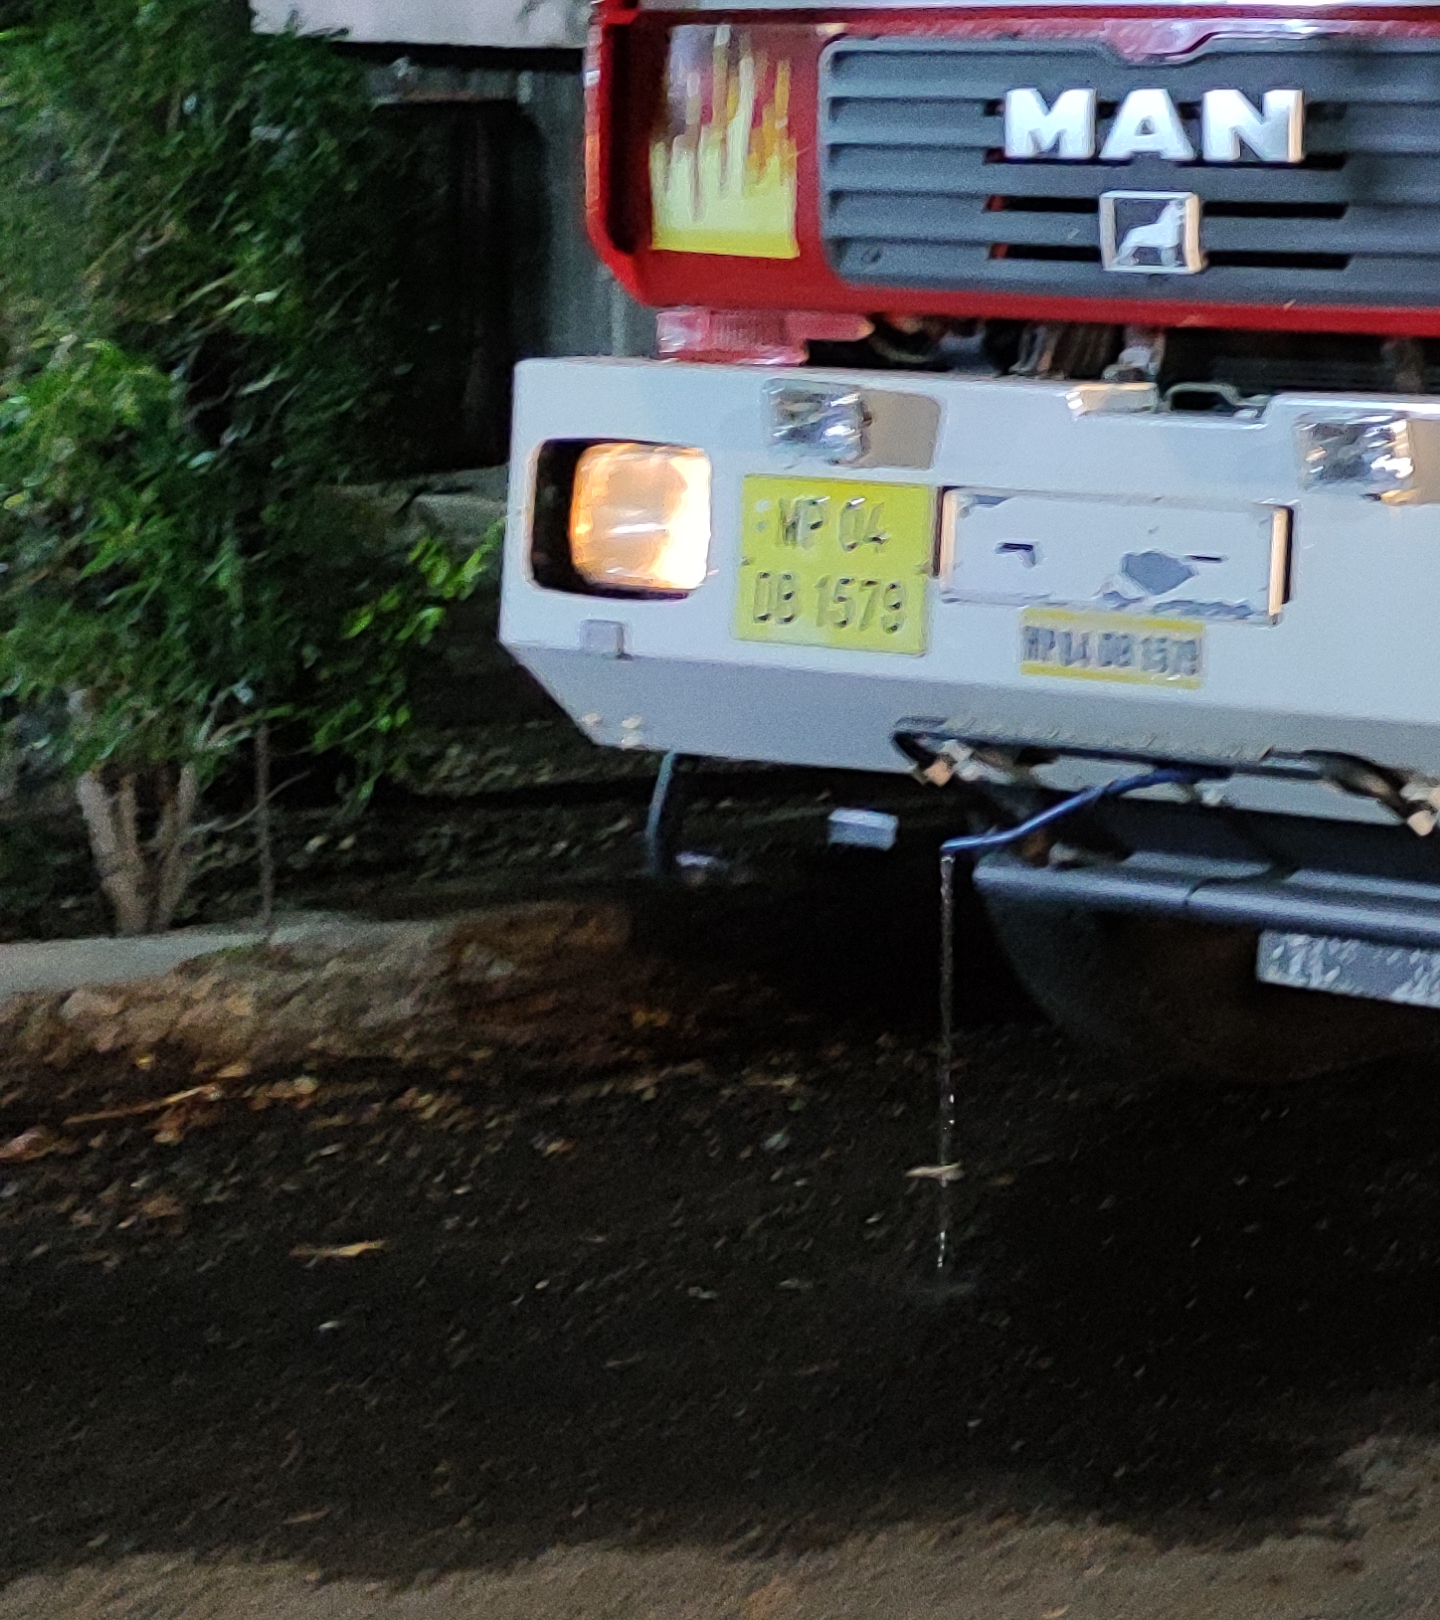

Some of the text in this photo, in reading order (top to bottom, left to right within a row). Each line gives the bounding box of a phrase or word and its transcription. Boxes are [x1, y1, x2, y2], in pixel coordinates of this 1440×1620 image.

[1004, 87, 1306, 163] MAN
[838, 496, 892, 554] 04
[814, 575, 908, 634] 1579
